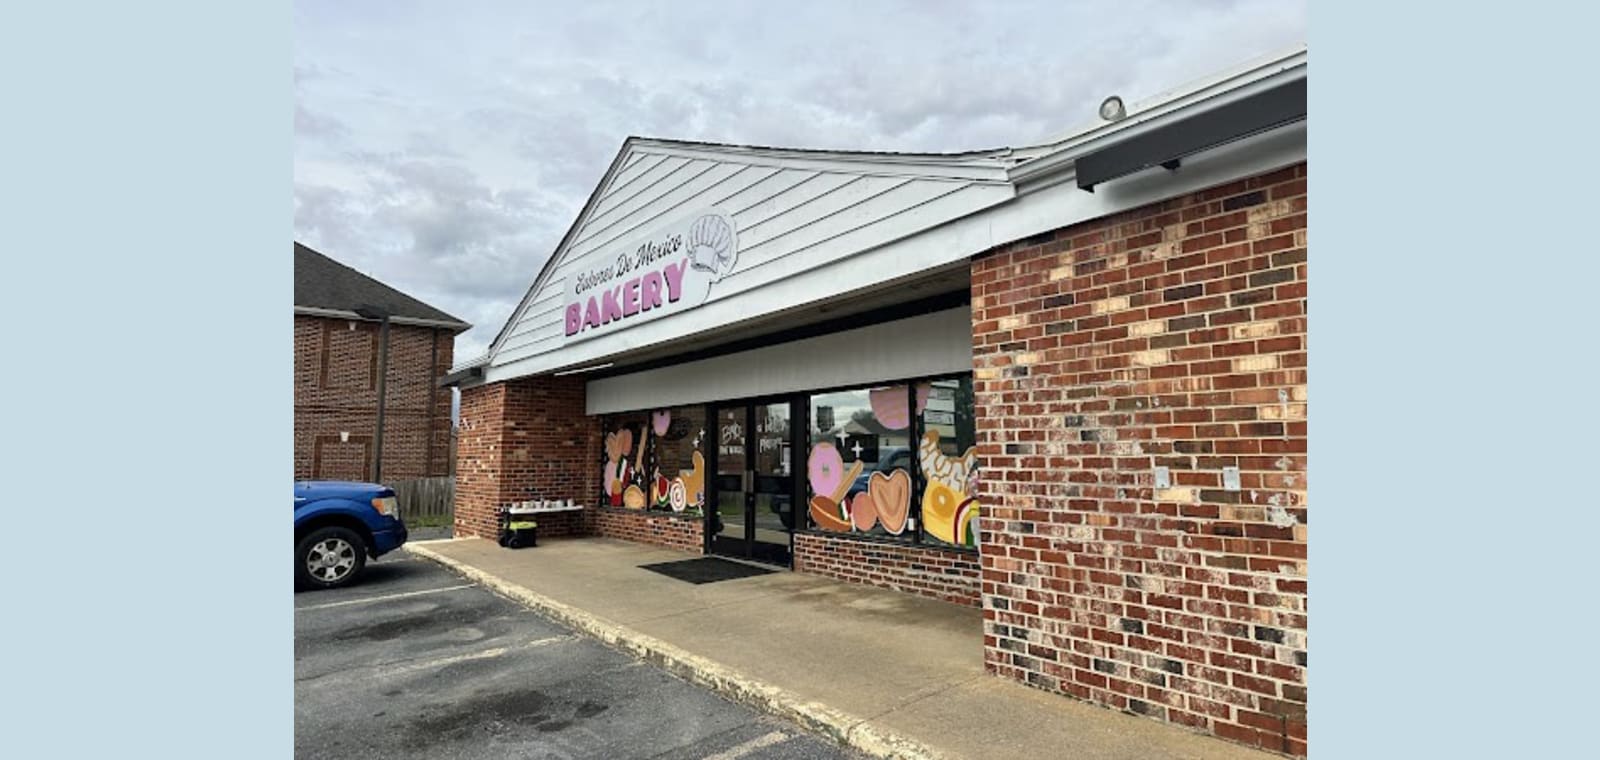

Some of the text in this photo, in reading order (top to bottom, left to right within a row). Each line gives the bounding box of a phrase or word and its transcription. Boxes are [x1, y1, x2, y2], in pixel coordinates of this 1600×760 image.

[615, 252, 634, 278] De
[634, 233, 682, 269] Mexico
[565, 257, 688, 337] BAKERY
